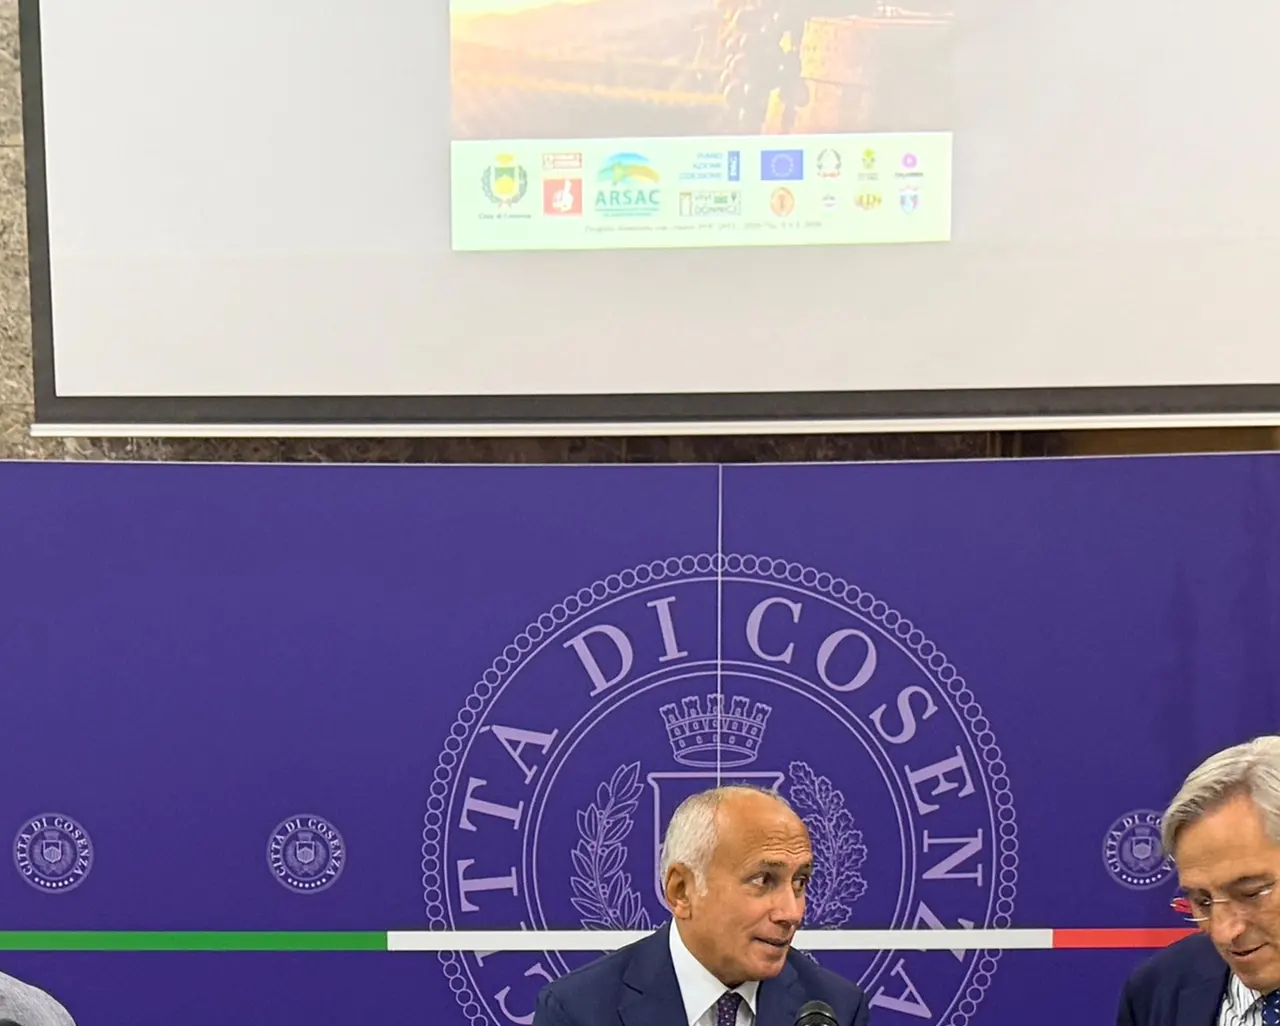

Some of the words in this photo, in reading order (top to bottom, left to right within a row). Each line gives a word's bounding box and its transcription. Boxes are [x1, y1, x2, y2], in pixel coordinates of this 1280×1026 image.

[595, 189, 661, 206] ARSAC
[564, 595, 688, 697] DI
[745, 596, 983, 1019] COSENZA
[1123, 814, 1139, 828] DI
[31, 817, 47, 831] DI
[54, 817, 89, 875] COSENZA
[285, 818, 301, 833] DI
[308, 818, 342, 876] COSENZA
